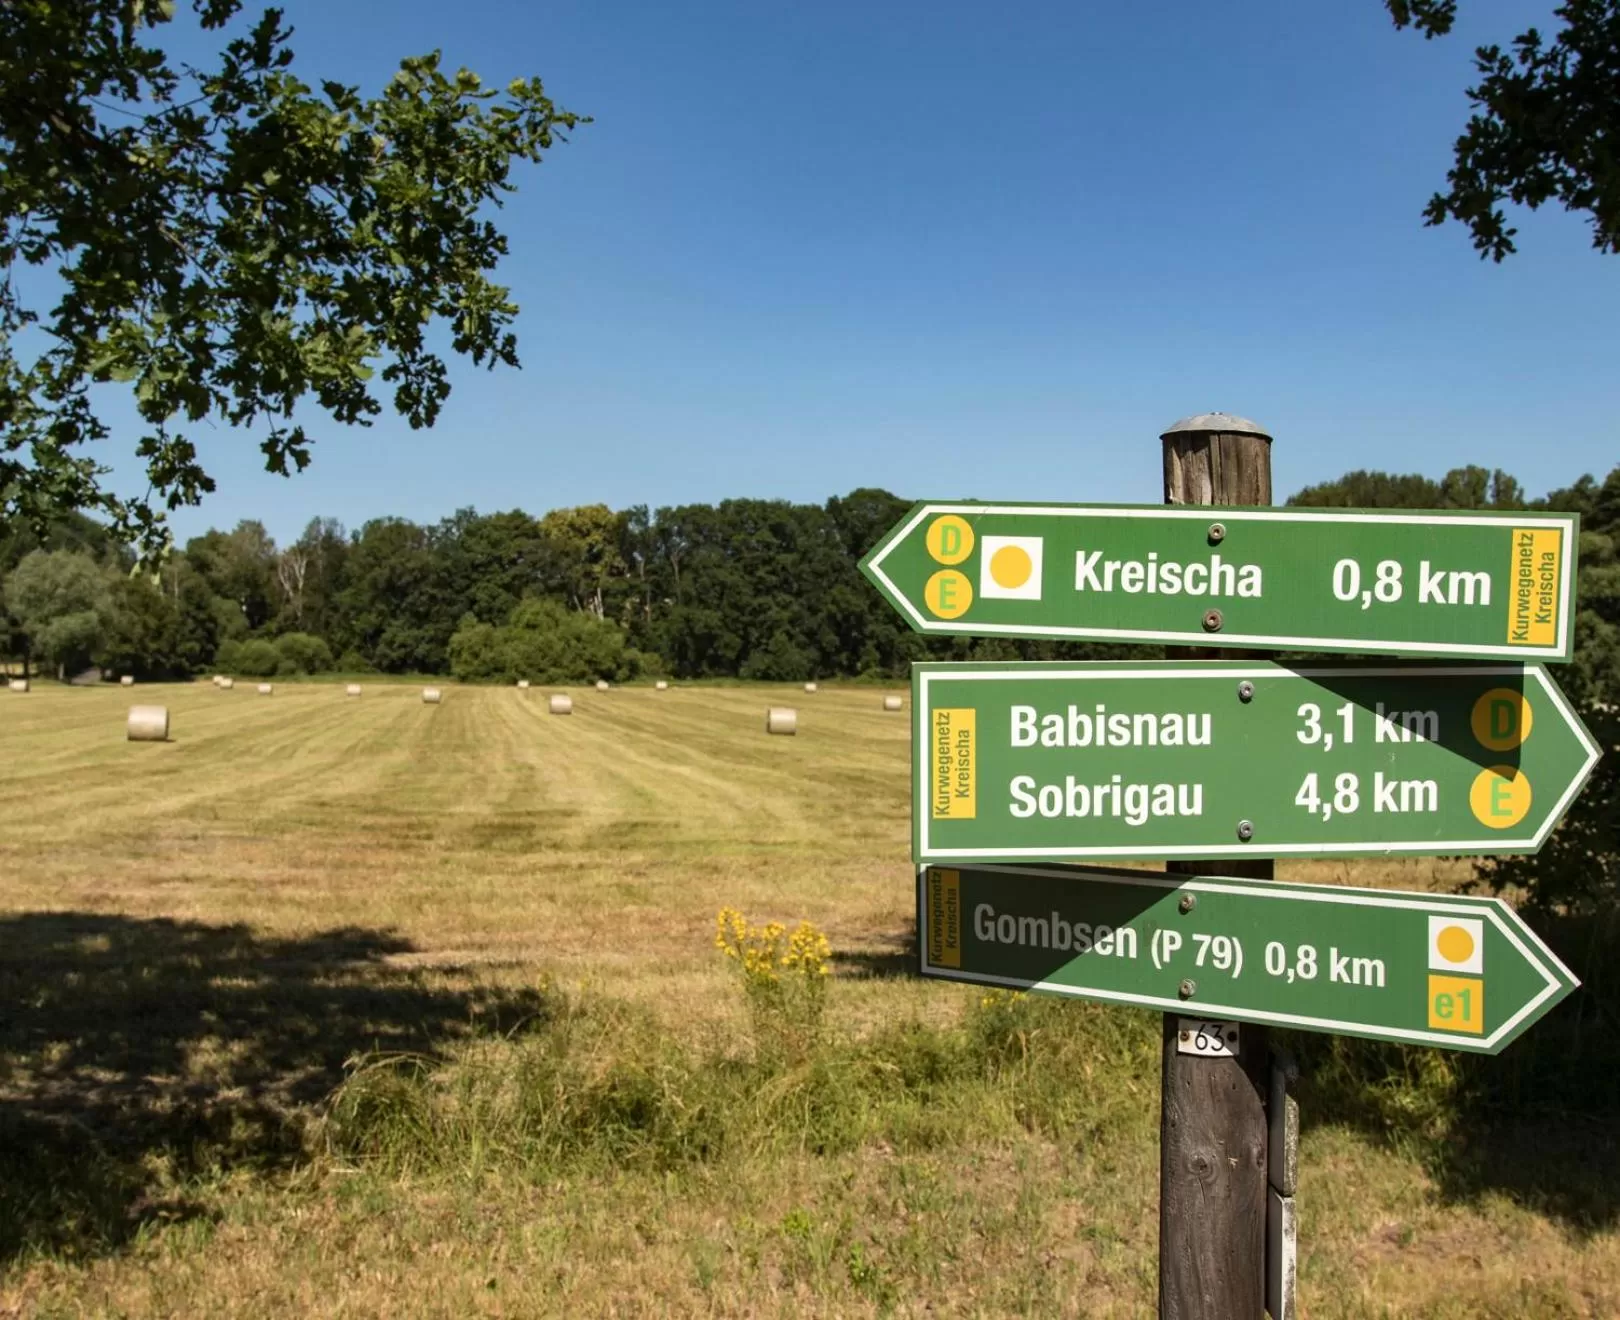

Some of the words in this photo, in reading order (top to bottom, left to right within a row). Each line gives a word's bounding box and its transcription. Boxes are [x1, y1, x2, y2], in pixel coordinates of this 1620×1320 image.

[940, 524, 962, 557] D
[938, 577, 957, 610] E
[1074, 550, 1263, 598] Kreischa
[1332, 558, 1402, 610] 0,8
[1418, 560, 1491, 606] km
[1511, 532, 1534, 642] Kurwegenetz
[1535, 551, 1556, 625] Kreischa
[1010, 704, 1212, 748] Babisnau
[1296, 702, 1355, 752] 3,1
[1374, 702, 1439, 743] km
[1490, 699, 1517, 740] D
[934, 711, 954, 816] Kurwegenetz
[954, 729, 970, 799] Kreischa
[1009, 774, 1204, 826] Sobrigau
[1295, 772, 1360, 822] 4,8
[1374, 771, 1438, 812] km
[1490, 777, 1513, 817] E
[929, 870, 945, 963] Kurwegenetz
[945, 887, 959, 949] Kreischa
[973, 903, 1137, 959] Gombsen
[1151, 928, 1182, 970] (P
[1191, 933, 1243, 979] 79)
[1264, 941, 1318, 984] 0,8
[1329, 947, 1386, 987] km
[1435, 988, 1471, 1021] e1
[1194, 1023, 1226, 1052] 63
